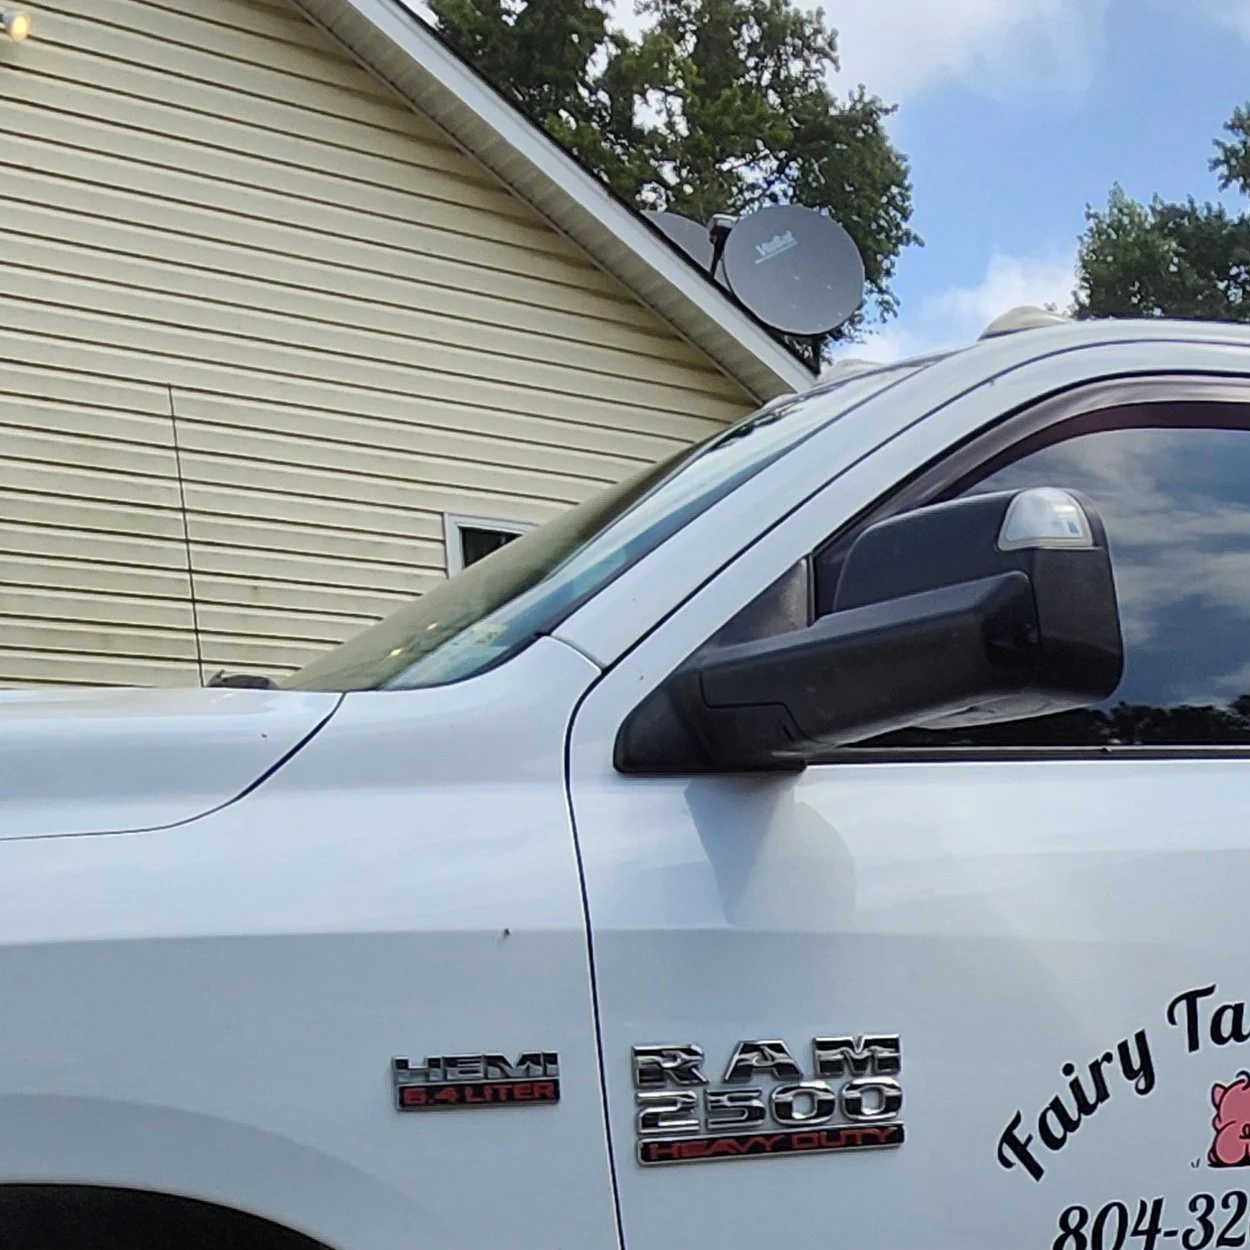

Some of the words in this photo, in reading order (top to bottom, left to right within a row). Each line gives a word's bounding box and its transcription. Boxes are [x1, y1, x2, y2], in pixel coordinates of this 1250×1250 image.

[391, 1051, 559, 1083] HEMI
[631, 1033, 902, 1089] RAM
[402, 1086, 459, 1105] 6.4
[464, 1082, 555, 1102] LITER
[635, 1076, 904, 1135] 2500
[997, 1028, 1157, 1183] Fairy
[650, 1135, 782, 1160] HEAVY
[791, 1126, 899, 1149] DUTY
